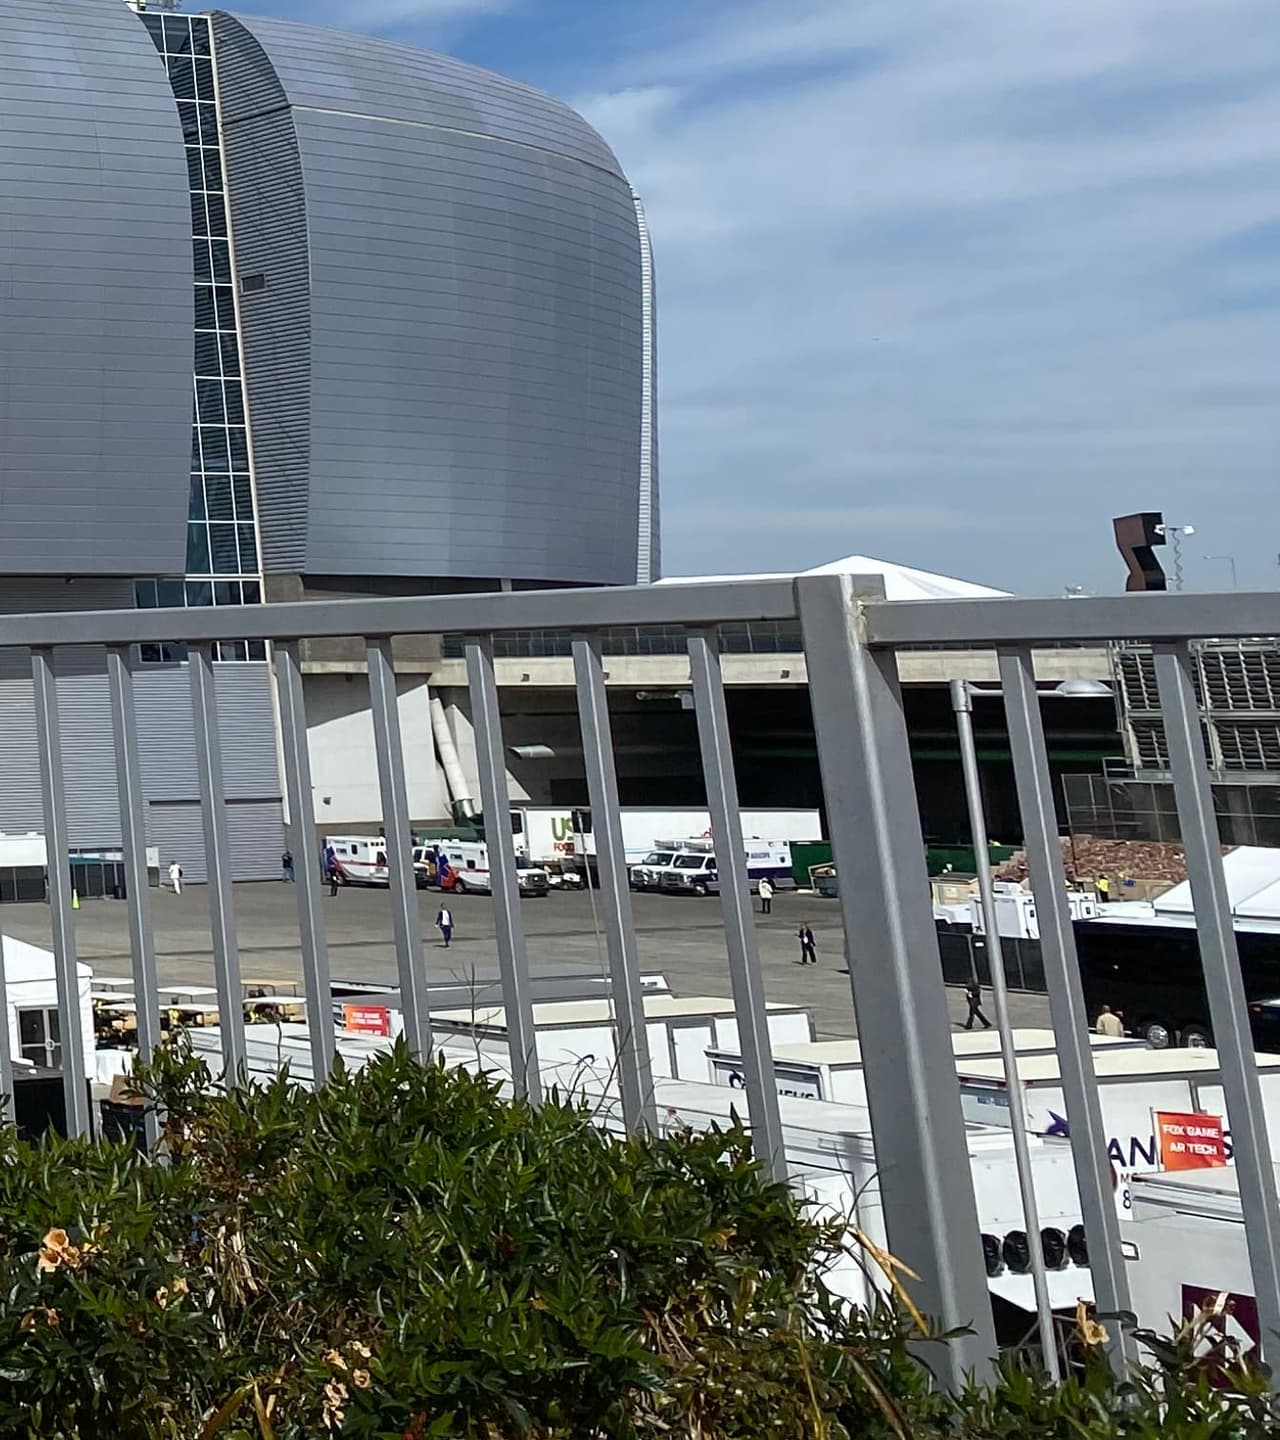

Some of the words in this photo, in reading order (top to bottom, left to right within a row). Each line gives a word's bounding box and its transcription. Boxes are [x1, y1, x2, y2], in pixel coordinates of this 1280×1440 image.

[1162, 1124, 1185, 1136] FOX
[1169, 1142, 1186, 1153] AR
[1186, 1143, 1218, 1156] TECH
